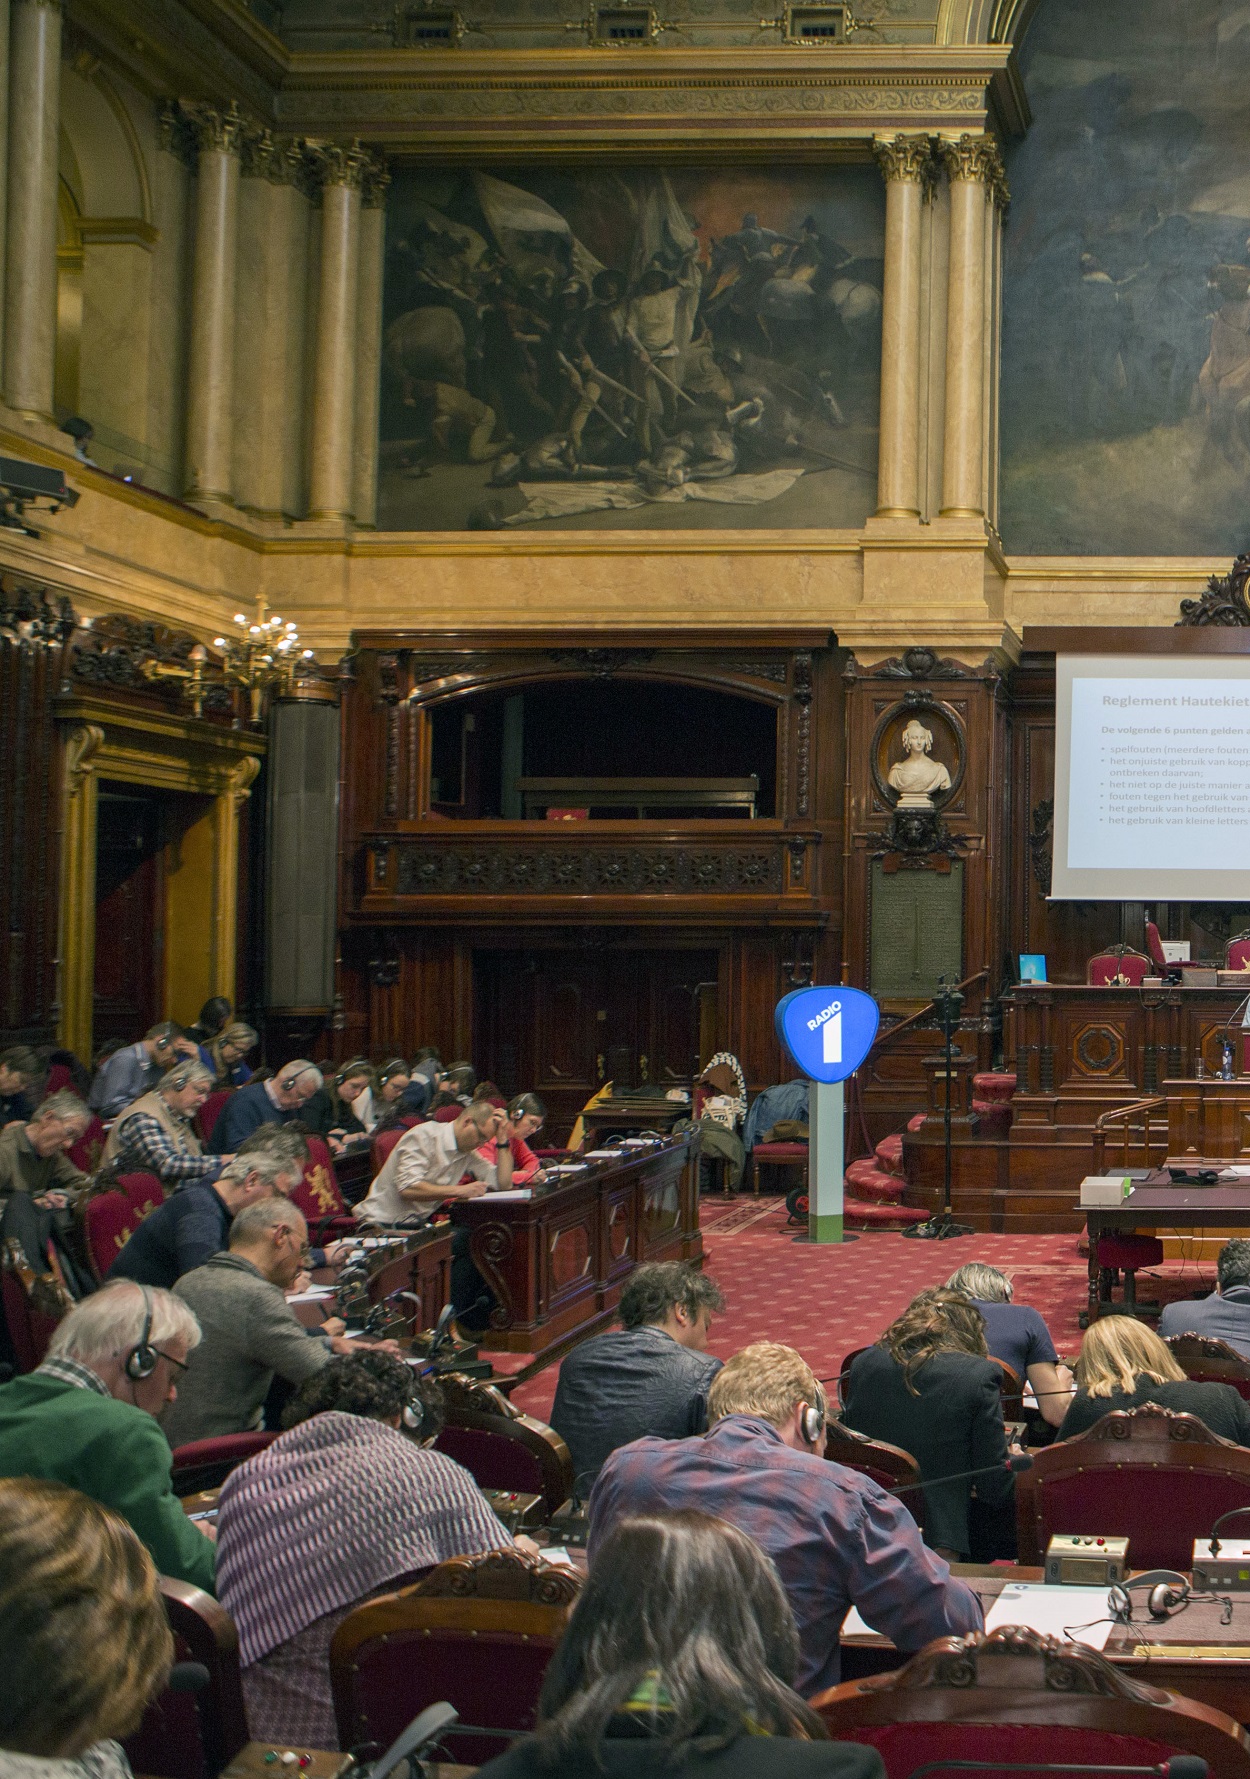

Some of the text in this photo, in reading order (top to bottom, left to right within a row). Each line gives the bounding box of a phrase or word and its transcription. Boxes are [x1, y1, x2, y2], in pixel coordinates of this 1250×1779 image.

[1103, 696, 1178, 708] Reglement
[1102, 726, 1115, 734] De
[1118, 726, 1161, 735] volgende
[1174, 728, 1207, 736] punten
[1211, 727, 1243, 736] gelden
[1110, 745, 1161, 754] spelfouten
[1164, 745, 1214, 755] (meerdere
[1217, 746, 1248, 754] fouten
[1110, 757, 1126, 765] het
[1128, 758, 1167, 767] onjuiste
[1170, 757, 1205, 767] gebruik
[1110, 769, 1203, 778] ontbreken daarvan;
[1110, 780, 1125, 788] het
[1150, 782, 1162, 790] op
[1165, 781, 1176, 789] de
[1180, 781, 1205, 790] juiste
[1109, 792, 1141, 800] fouten
[1144, 793, 1170, 802] tegen
[1192, 793, 1228, 802] gebruik
[1109, 804, 1124, 812] het
[1128, 804, 1163, 814] gebruik
[1186, 805, 1245, 814] hoofdletters
[1109, 816, 1124, 824] het
[1127, 816, 1163, 826] gebruik
[1186, 817, 1215, 825] kleine
[1218, 817, 1247, 825] letters
[807, 1001, 842, 1031] RADIO
[823, 1011, 842, 1063] 1
